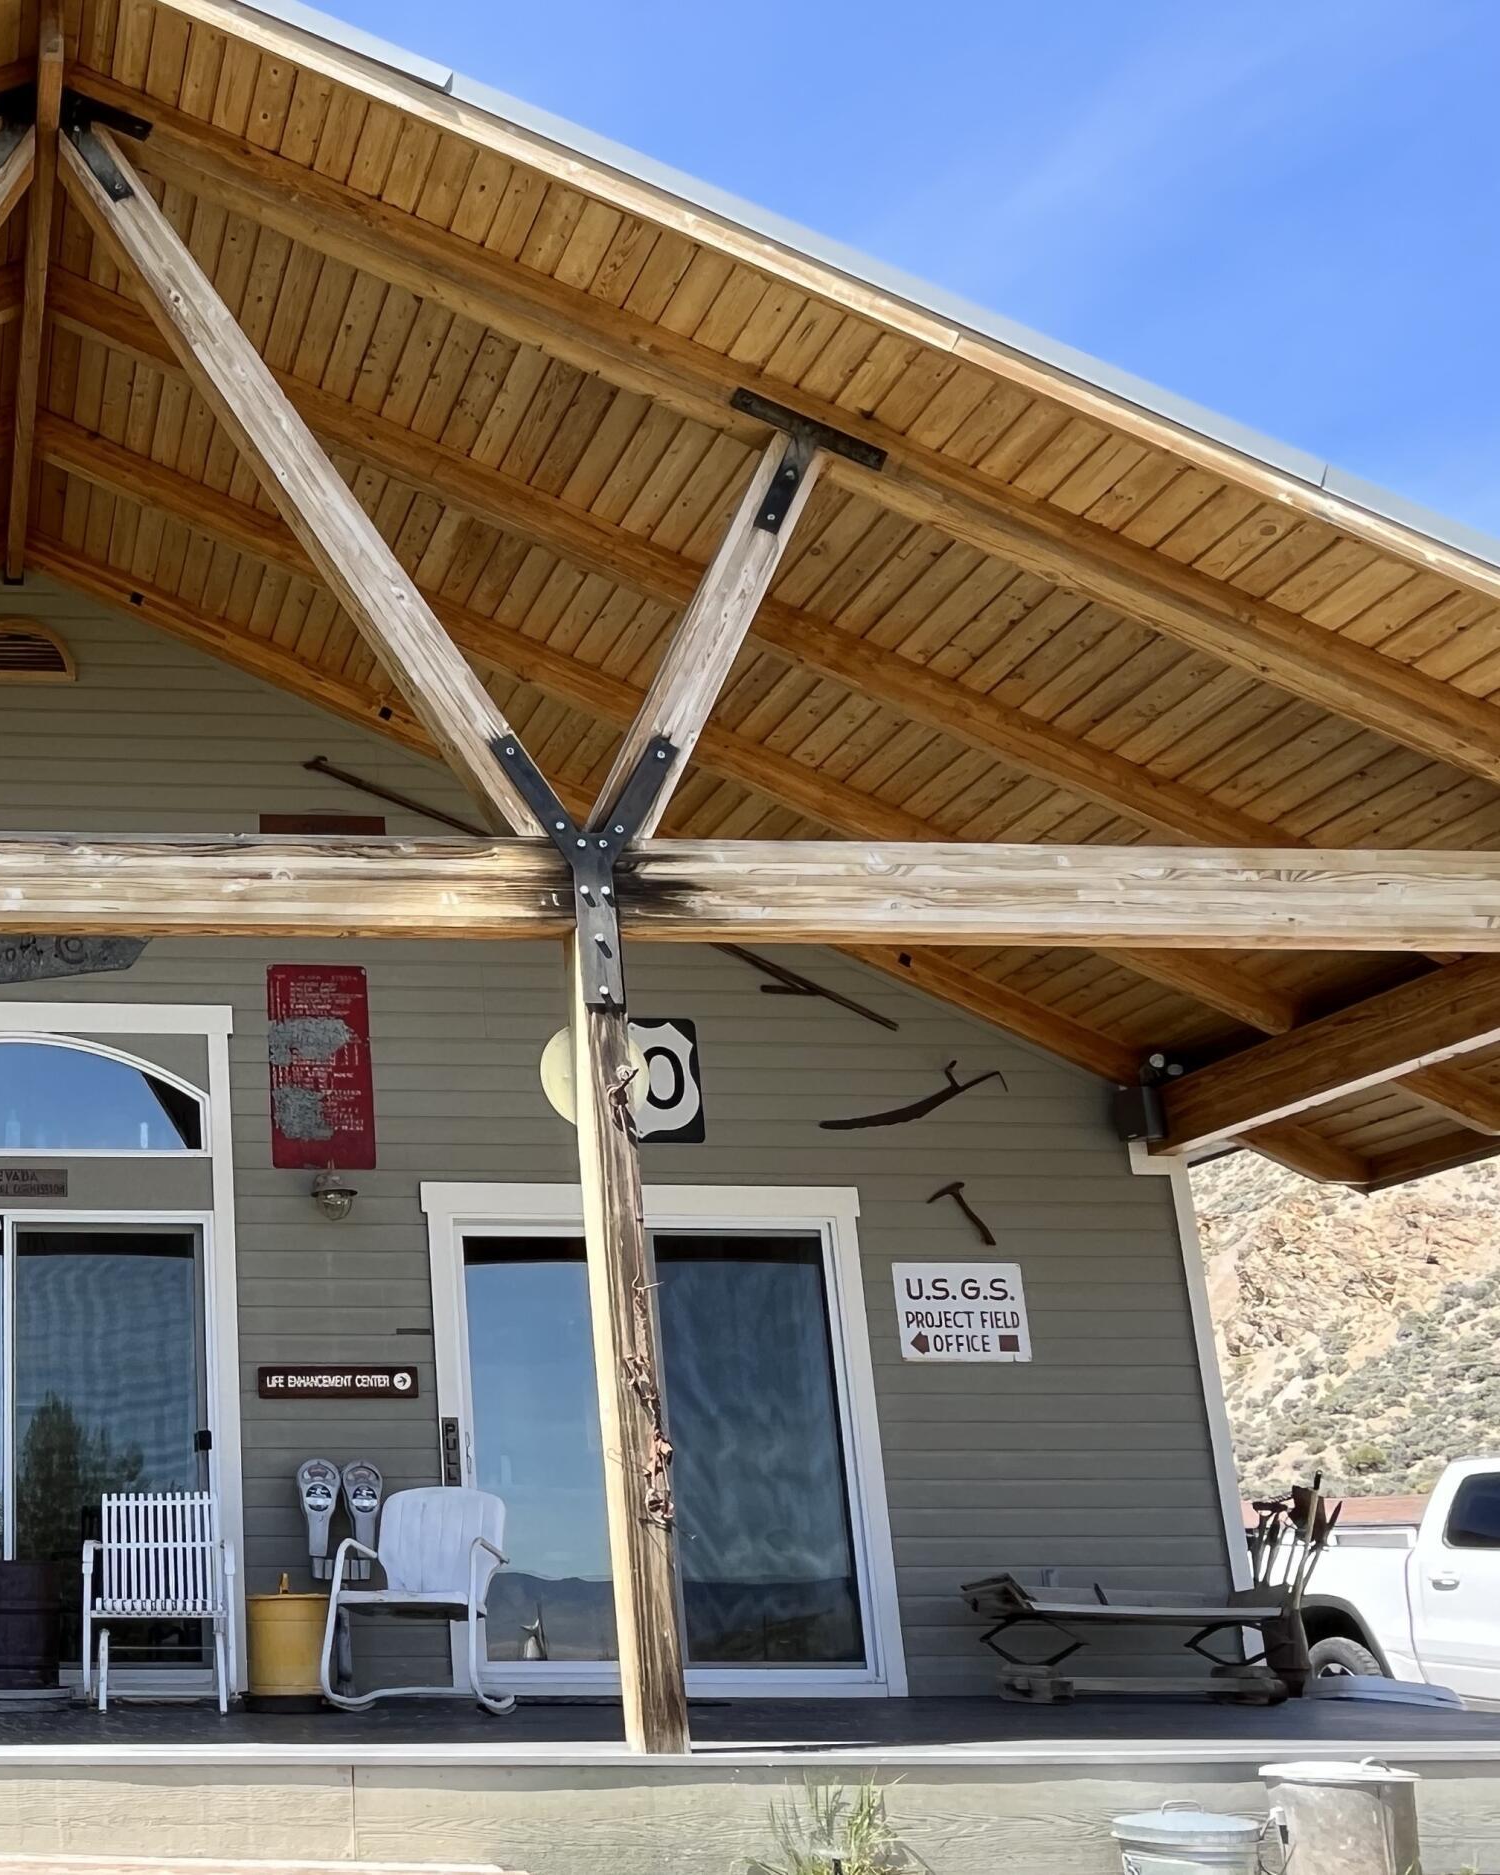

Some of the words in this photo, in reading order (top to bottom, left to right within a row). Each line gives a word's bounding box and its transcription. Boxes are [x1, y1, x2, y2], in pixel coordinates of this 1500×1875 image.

[905, 1278, 1015, 1301] U.S.G.S.
[905, 1311, 974, 1328] PROJECT
[980, 1311, 1020, 1328] FIELD
[933, 1334, 991, 1352] OFFICE
[266, 1375, 285, 1387] LIFE
[287, 1375, 352, 1388] ENHANCEMENT
[355, 1375, 390, 1387] CENTER
[445, 1423, 457, 1480] PULL
